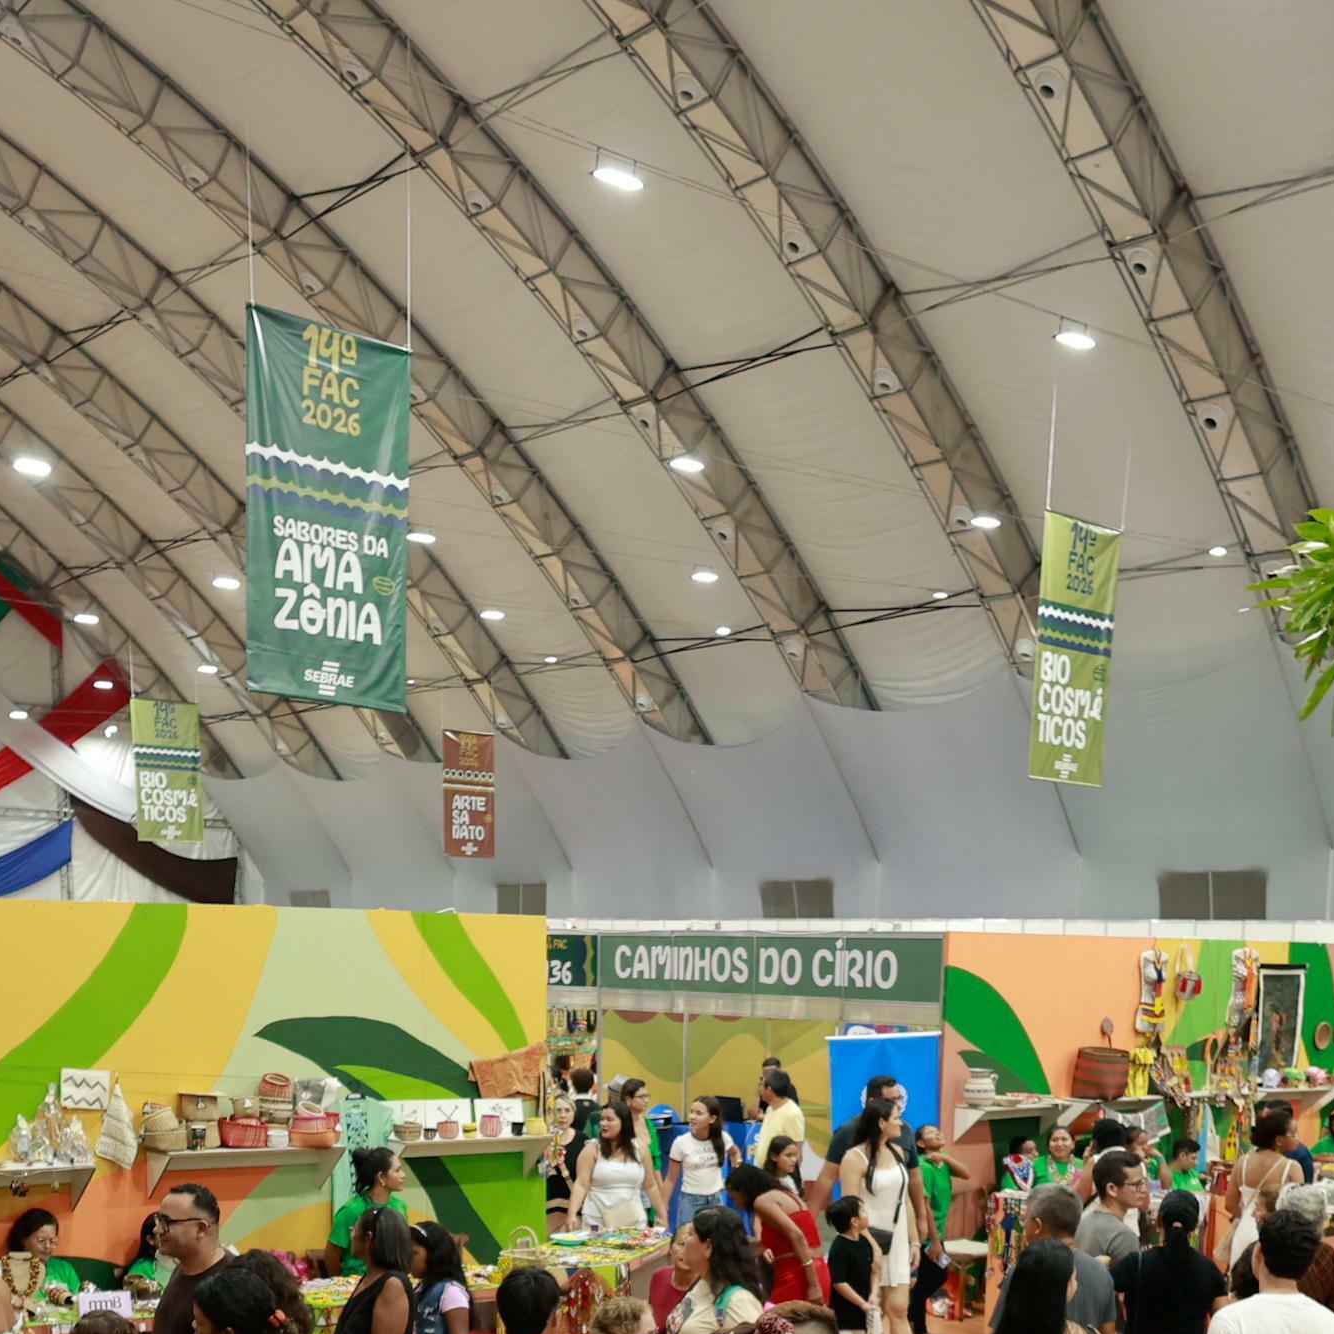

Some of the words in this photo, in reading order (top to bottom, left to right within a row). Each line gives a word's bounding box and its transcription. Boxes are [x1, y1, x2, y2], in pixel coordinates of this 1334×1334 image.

[301, 366, 360, 408] FAC
[301, 400, 361, 436] 2026
[273, 515, 359, 553] SABORES
[364, 534, 388, 558] DA
[274, 538, 364, 595] AMA
[1068, 551, 1095, 576] FAC
[1067, 573, 1094, 596] 2026
[303, 668, 354, 688] SEBRAE
[1041, 651, 1071, 684] BIO
[154, 717, 177, 730] FAC
[1037, 713, 1087, 750] TICOS
[140, 771, 167, 788] BIO
[142, 805, 187, 823] TICOS
[452, 794, 486, 811] ARTE
[452, 810, 470, 825] SA
[548, 959, 572, 985] 36
[614, 944, 749, 984] CAMINHOS
[759, 947, 803, 986] DO
[812, 939, 898, 989] CÍRIO
